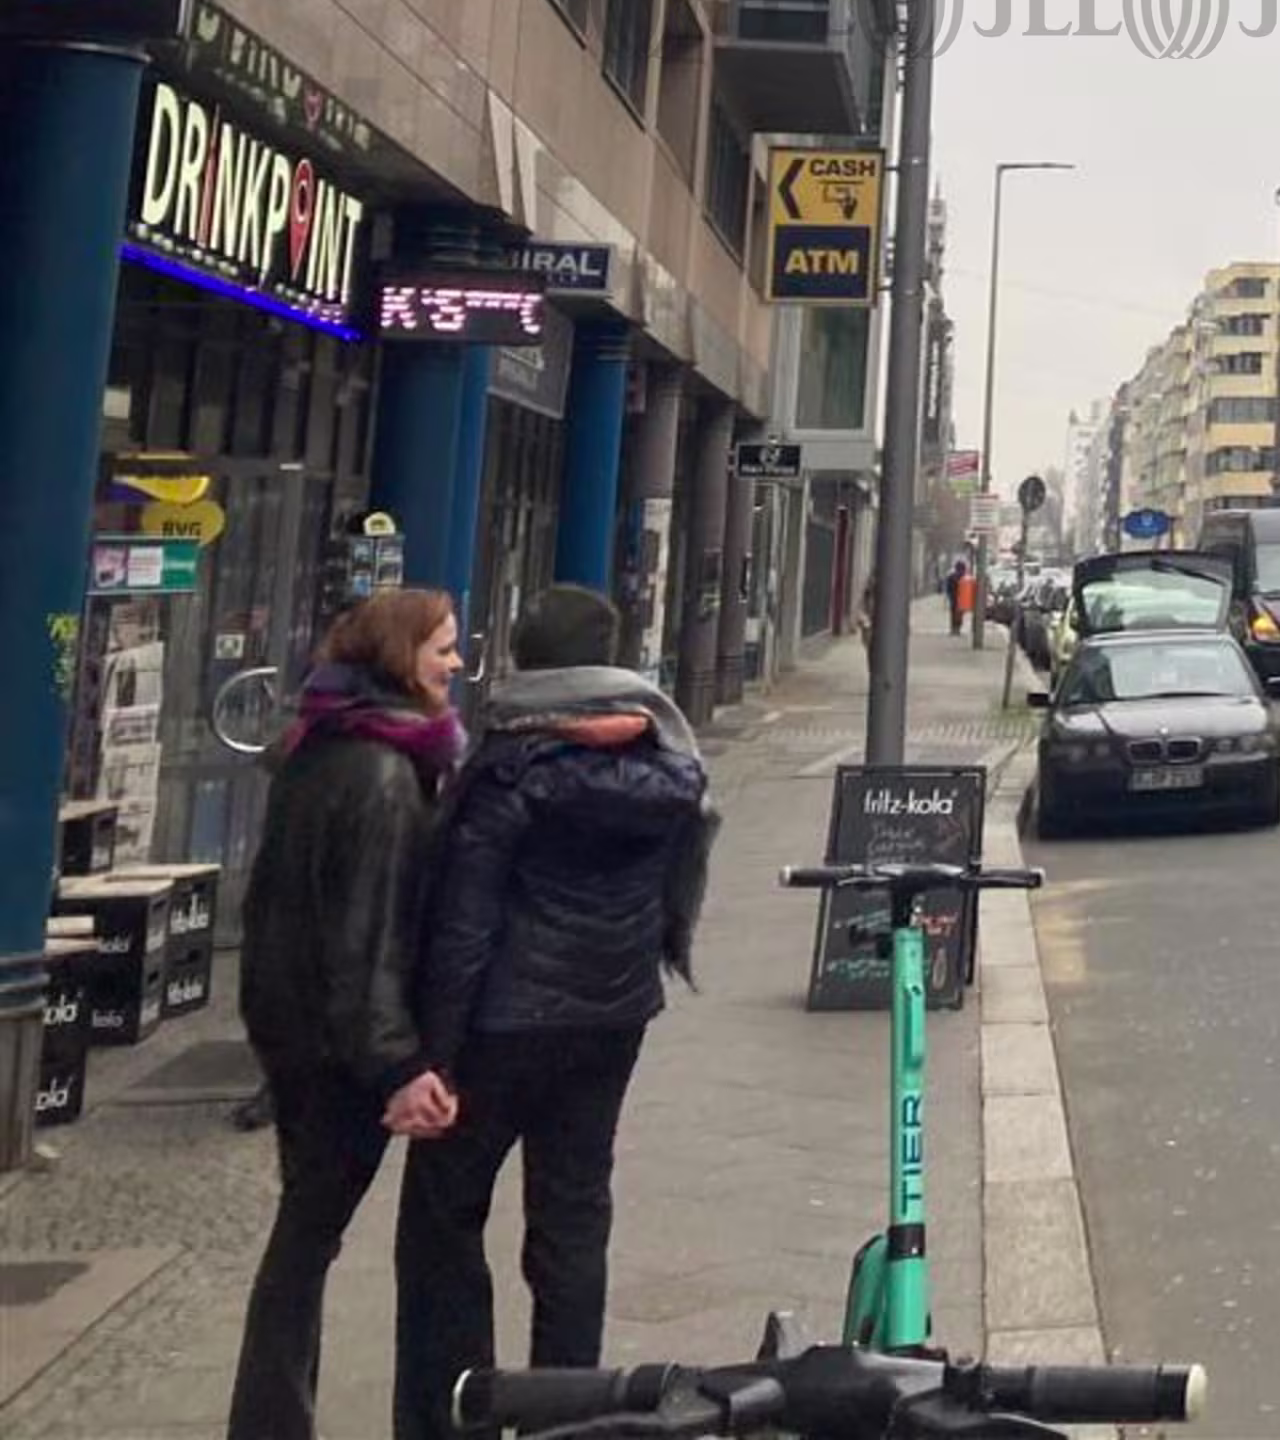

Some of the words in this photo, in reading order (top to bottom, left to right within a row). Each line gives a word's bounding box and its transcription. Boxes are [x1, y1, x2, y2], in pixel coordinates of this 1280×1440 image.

[809, 159, 876, 178] CASH
[785, 248, 859, 275] ATM
[863, 789, 954, 814] fritz-kola
[902, 1094, 924, 1217] TIER
